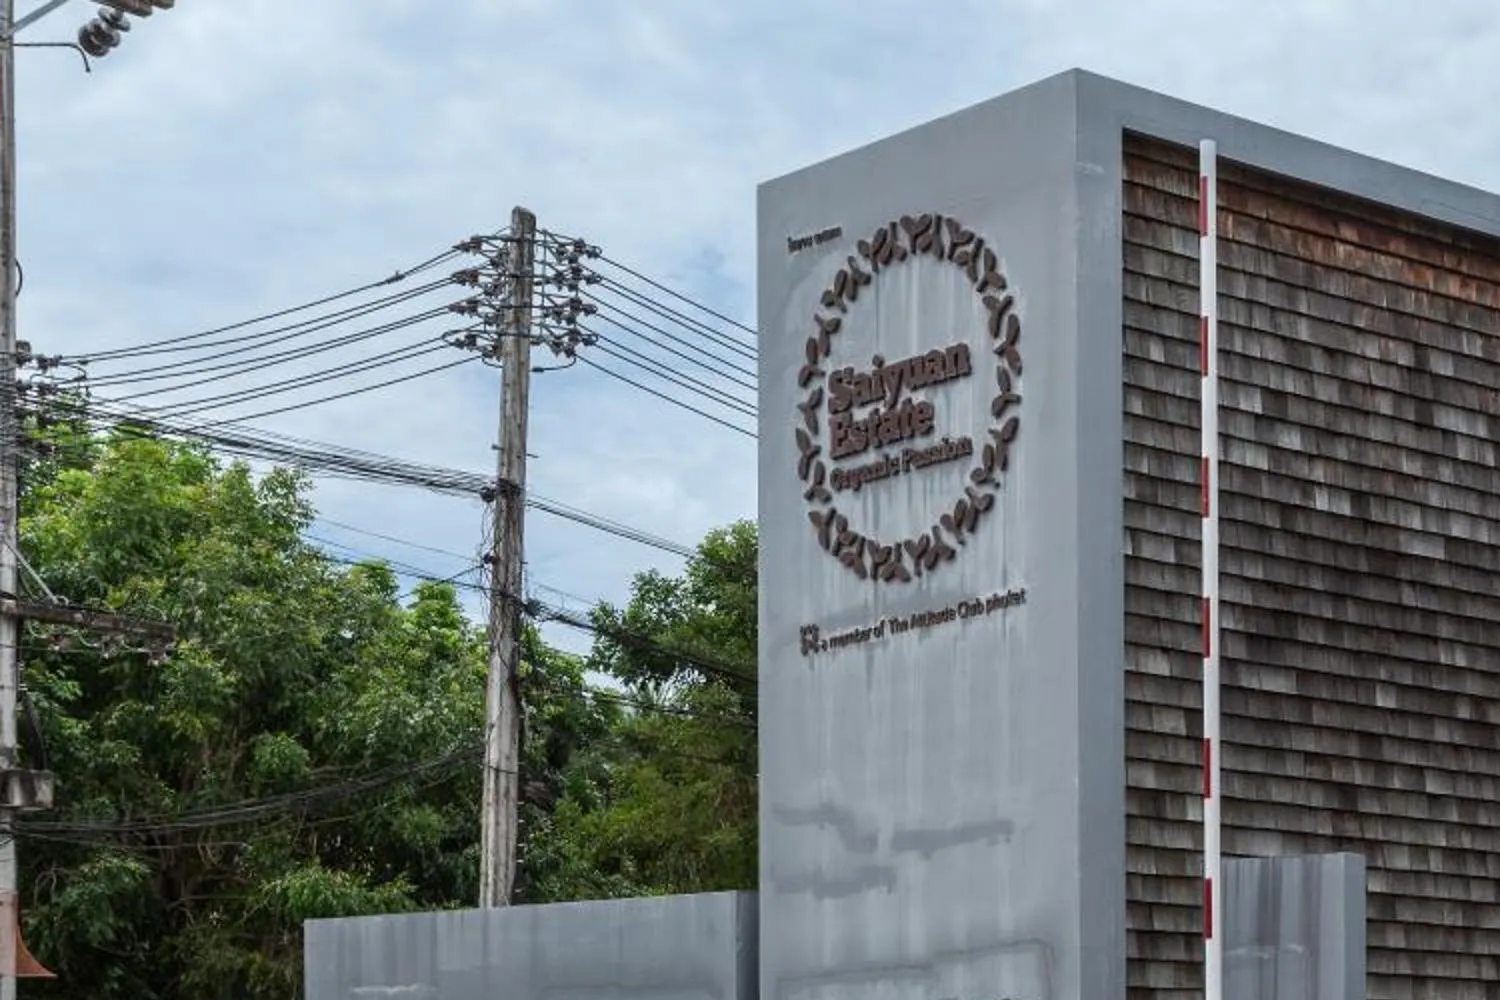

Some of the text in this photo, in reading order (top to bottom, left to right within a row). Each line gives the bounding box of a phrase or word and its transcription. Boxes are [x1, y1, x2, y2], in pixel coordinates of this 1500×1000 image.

[829, 343, 971, 413] Saiyuan
[829, 398, 934, 460] Estate
[829, 626, 873, 650] member
[874, 621, 885, 639] of
